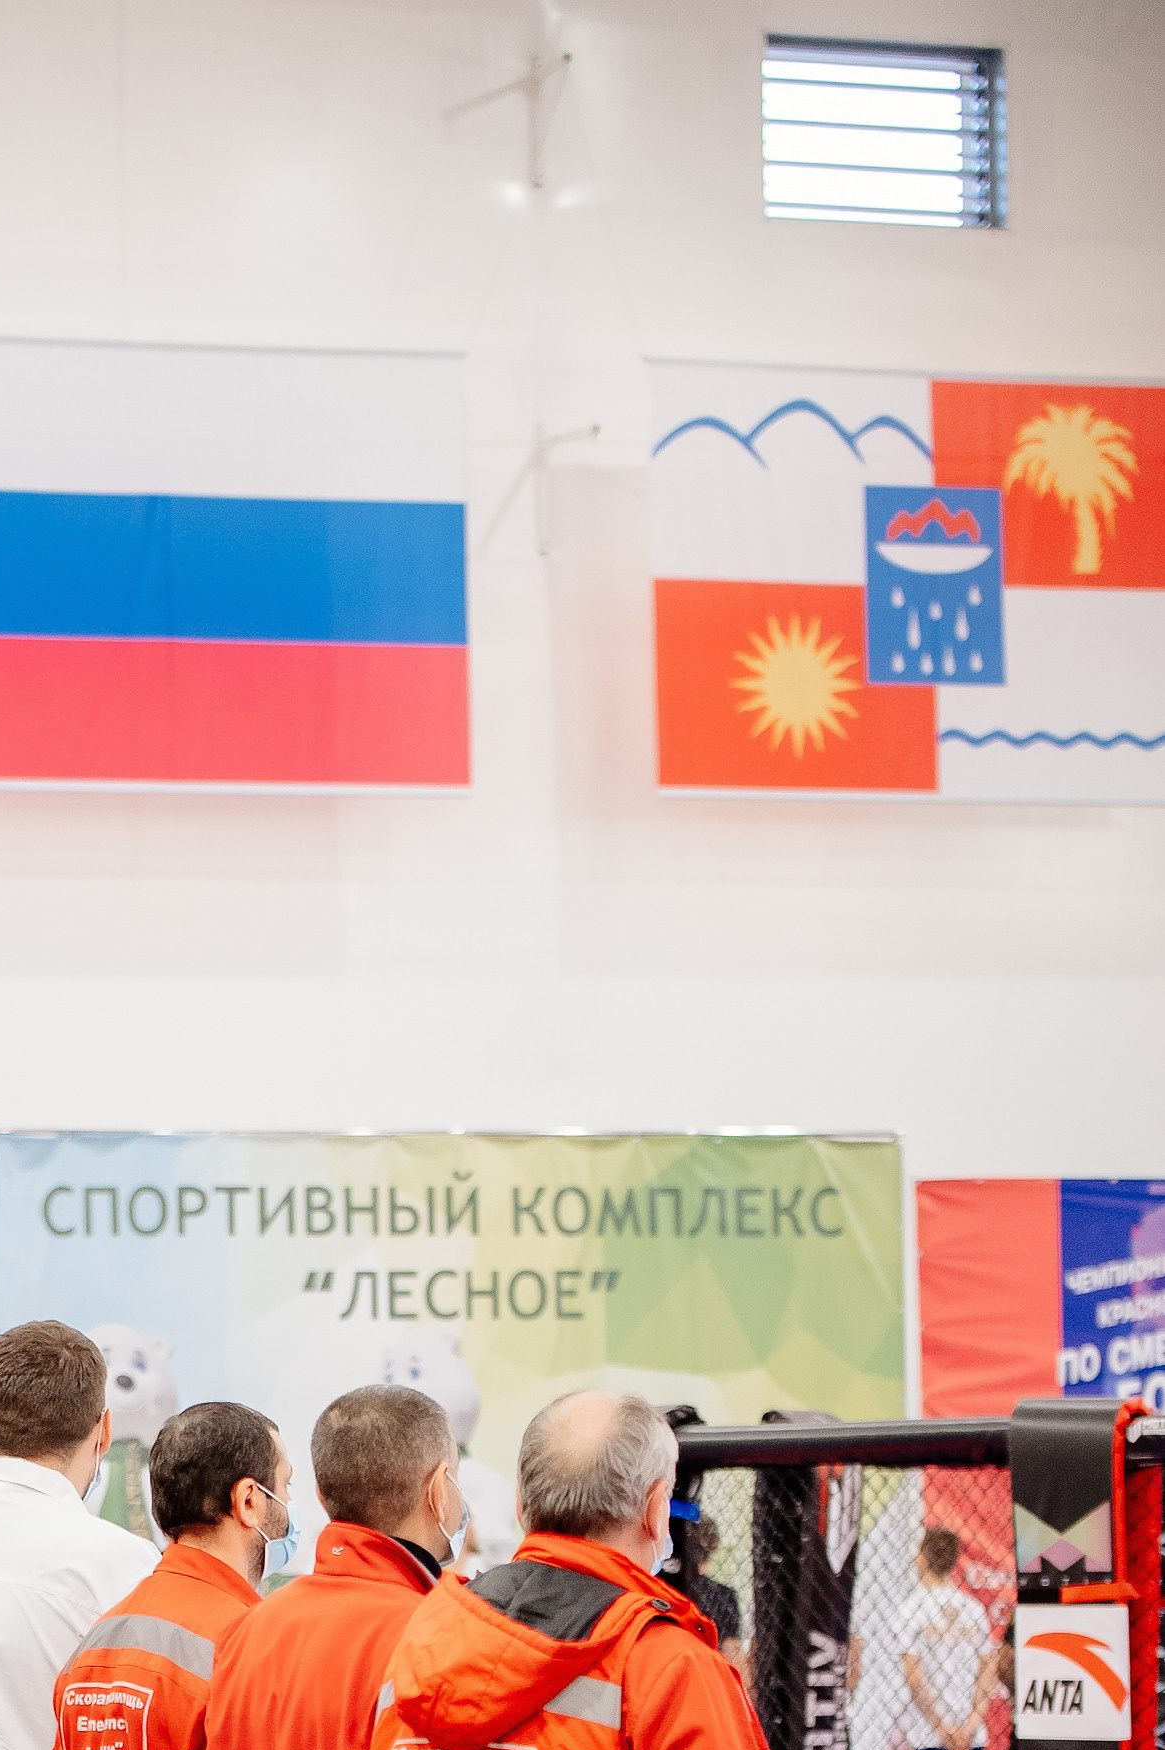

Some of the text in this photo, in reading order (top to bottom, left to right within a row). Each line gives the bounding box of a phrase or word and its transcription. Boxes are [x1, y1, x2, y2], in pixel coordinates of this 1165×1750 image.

[42, 1169, 846, 1238] СПОРТИВНЫЙ КОМПЛЕКС
[1056, 1343, 1102, 1387] ПО
[1021, 1678, 1085, 1716] ANTA
